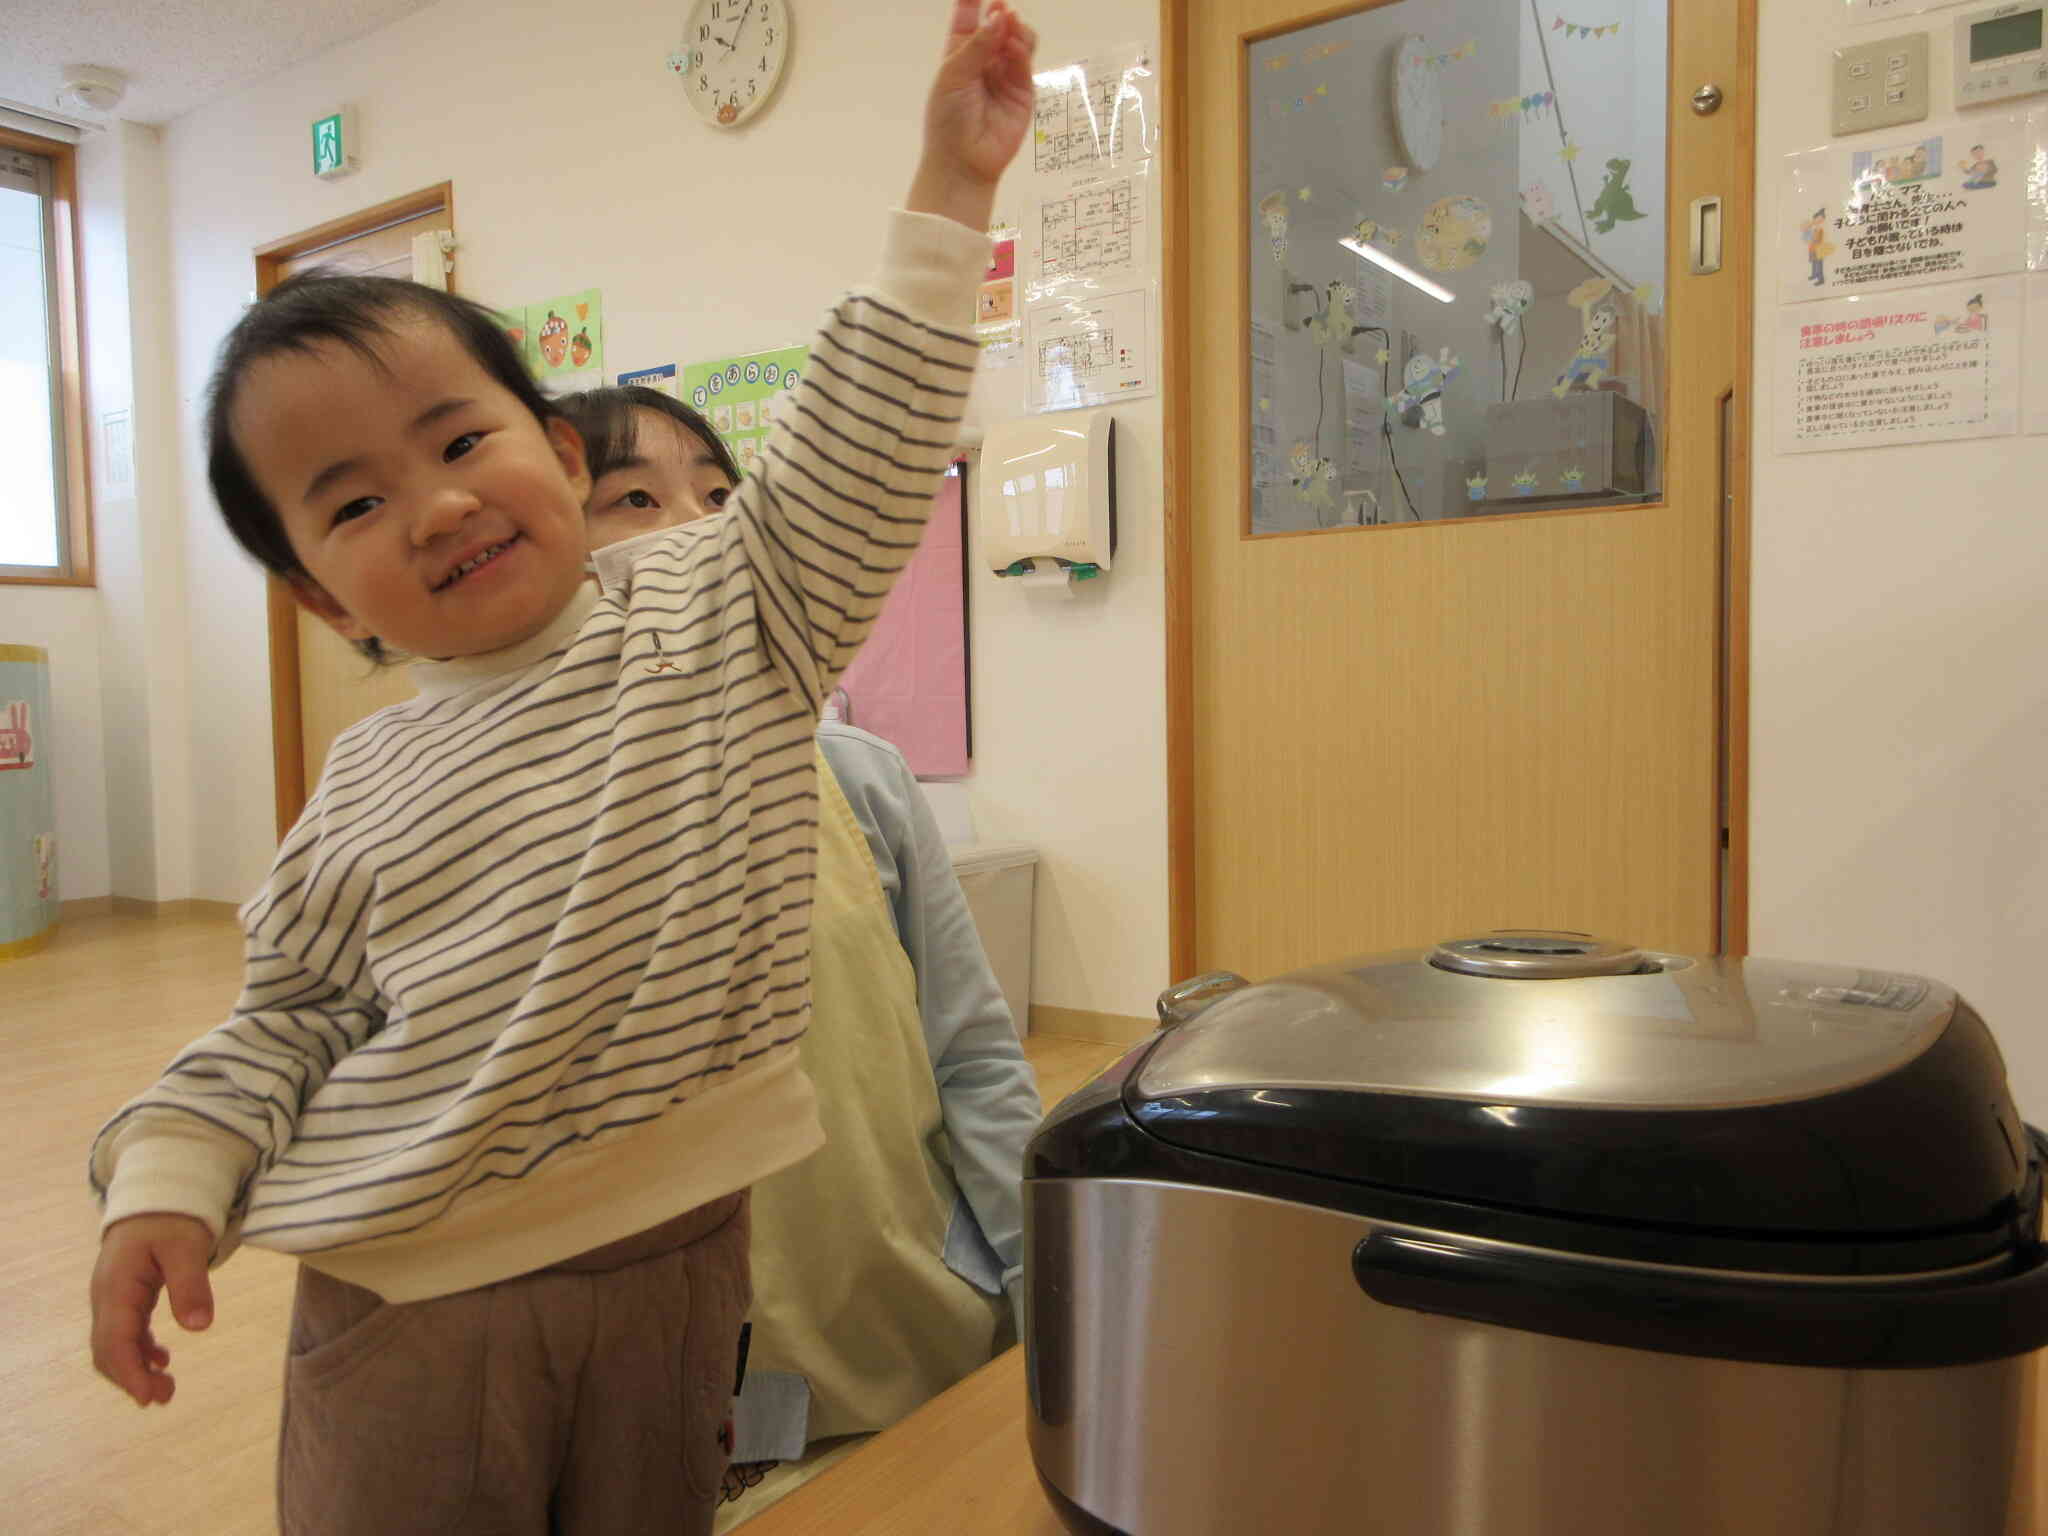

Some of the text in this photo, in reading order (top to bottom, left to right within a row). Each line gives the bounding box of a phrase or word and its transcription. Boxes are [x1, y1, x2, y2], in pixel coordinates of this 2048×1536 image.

[711, 1, 720, 21] 11
[760, 4, 769, 22] 2
[699, 24, 710, 42] 10
[764, 28, 773, 46] 3
[695, 51, 703, 68] 9
[758, 55, 766, 72] 4
[699, 74, 708, 92] 8
[748, 80, 756, 96] 5
[713, 89, 720, 106] 7
[729, 90, 738, 105] 6
